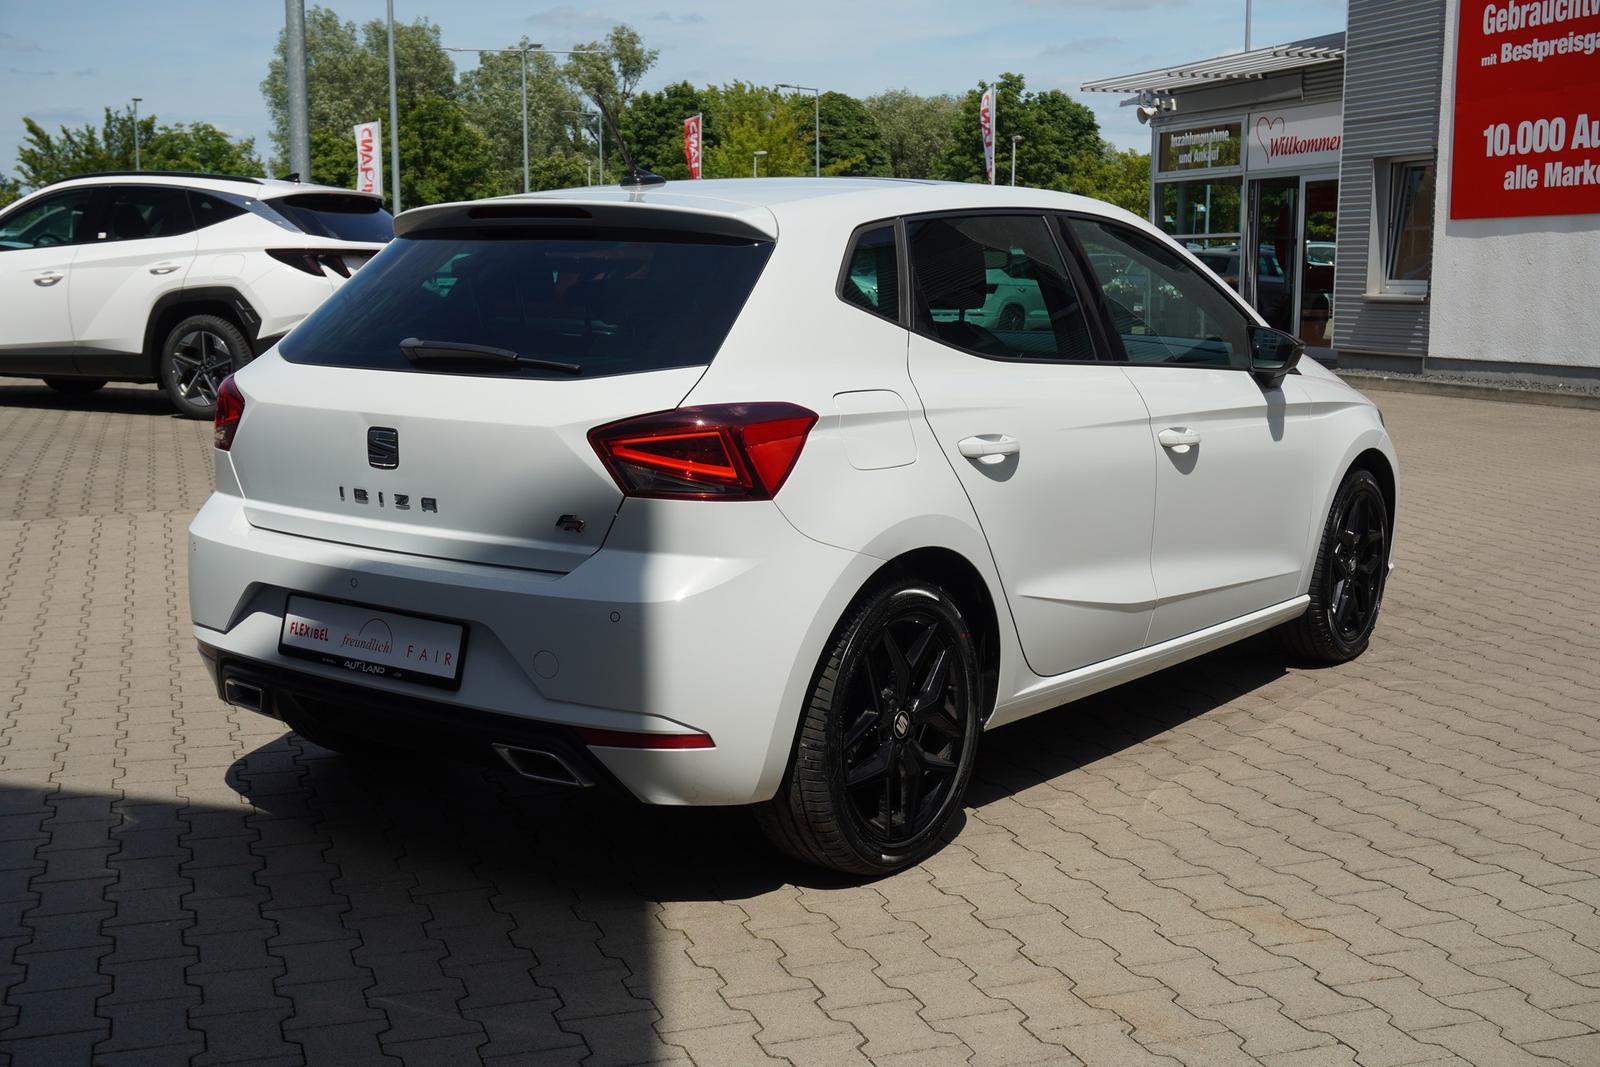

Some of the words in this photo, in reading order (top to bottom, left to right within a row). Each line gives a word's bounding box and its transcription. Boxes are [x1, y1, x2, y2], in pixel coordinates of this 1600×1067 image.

[1481, 54, 1497, 66] mit
[1483, 117, 1566, 157] 10.000
[1179, 151, 1193, 164] und
[1194, 147, 1220, 162] Ankauf
[1503, 164, 1538, 190] alle
[339, 486, 438, 513] IBIZA
[289, 622, 329, 641] FLEXIBEL
[340, 633, 391, 654] freundlich
[407, 645, 453, 666] FAIR
